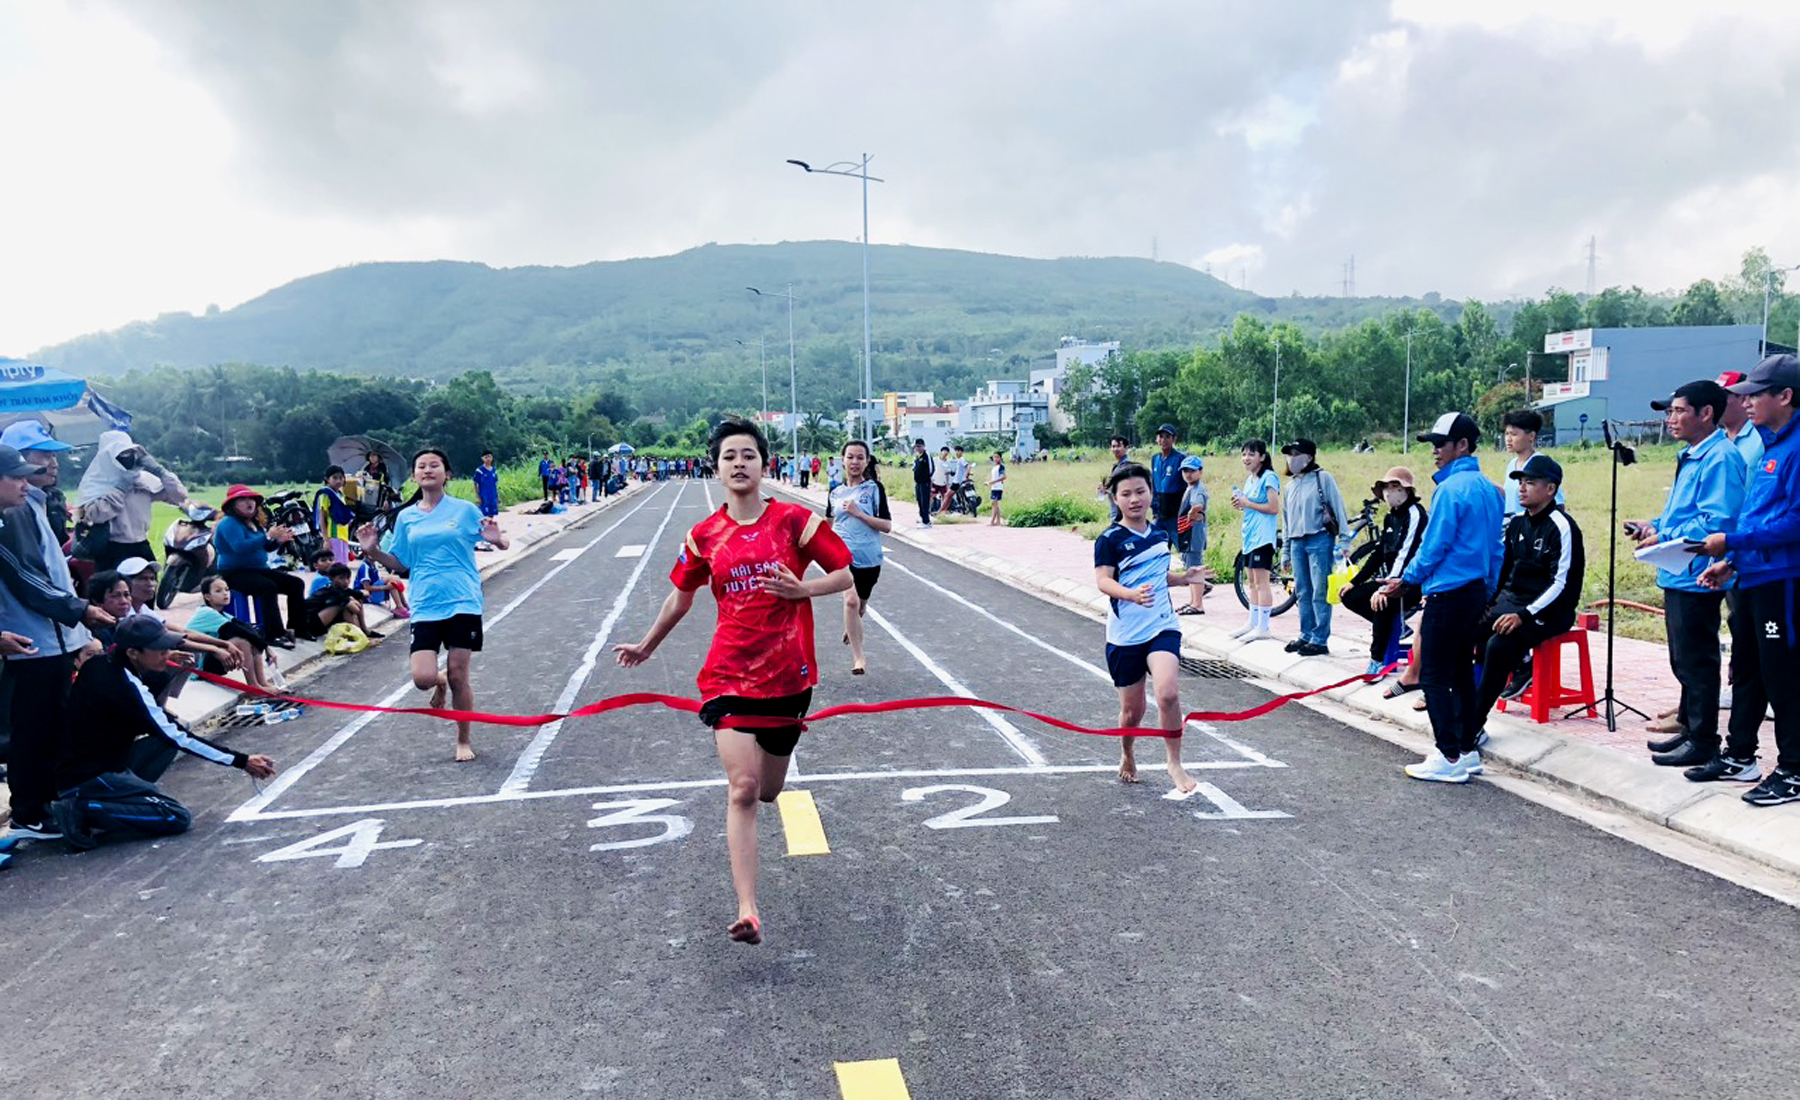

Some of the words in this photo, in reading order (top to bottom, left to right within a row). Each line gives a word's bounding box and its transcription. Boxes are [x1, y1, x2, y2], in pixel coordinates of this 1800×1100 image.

[724, 575, 766, 593] TUYẾ
[901, 784, 1061, 829] 2
[1161, 782, 1295, 820] 1
[252, 818, 424, 867] 4
[587, 799, 694, 851] 3
